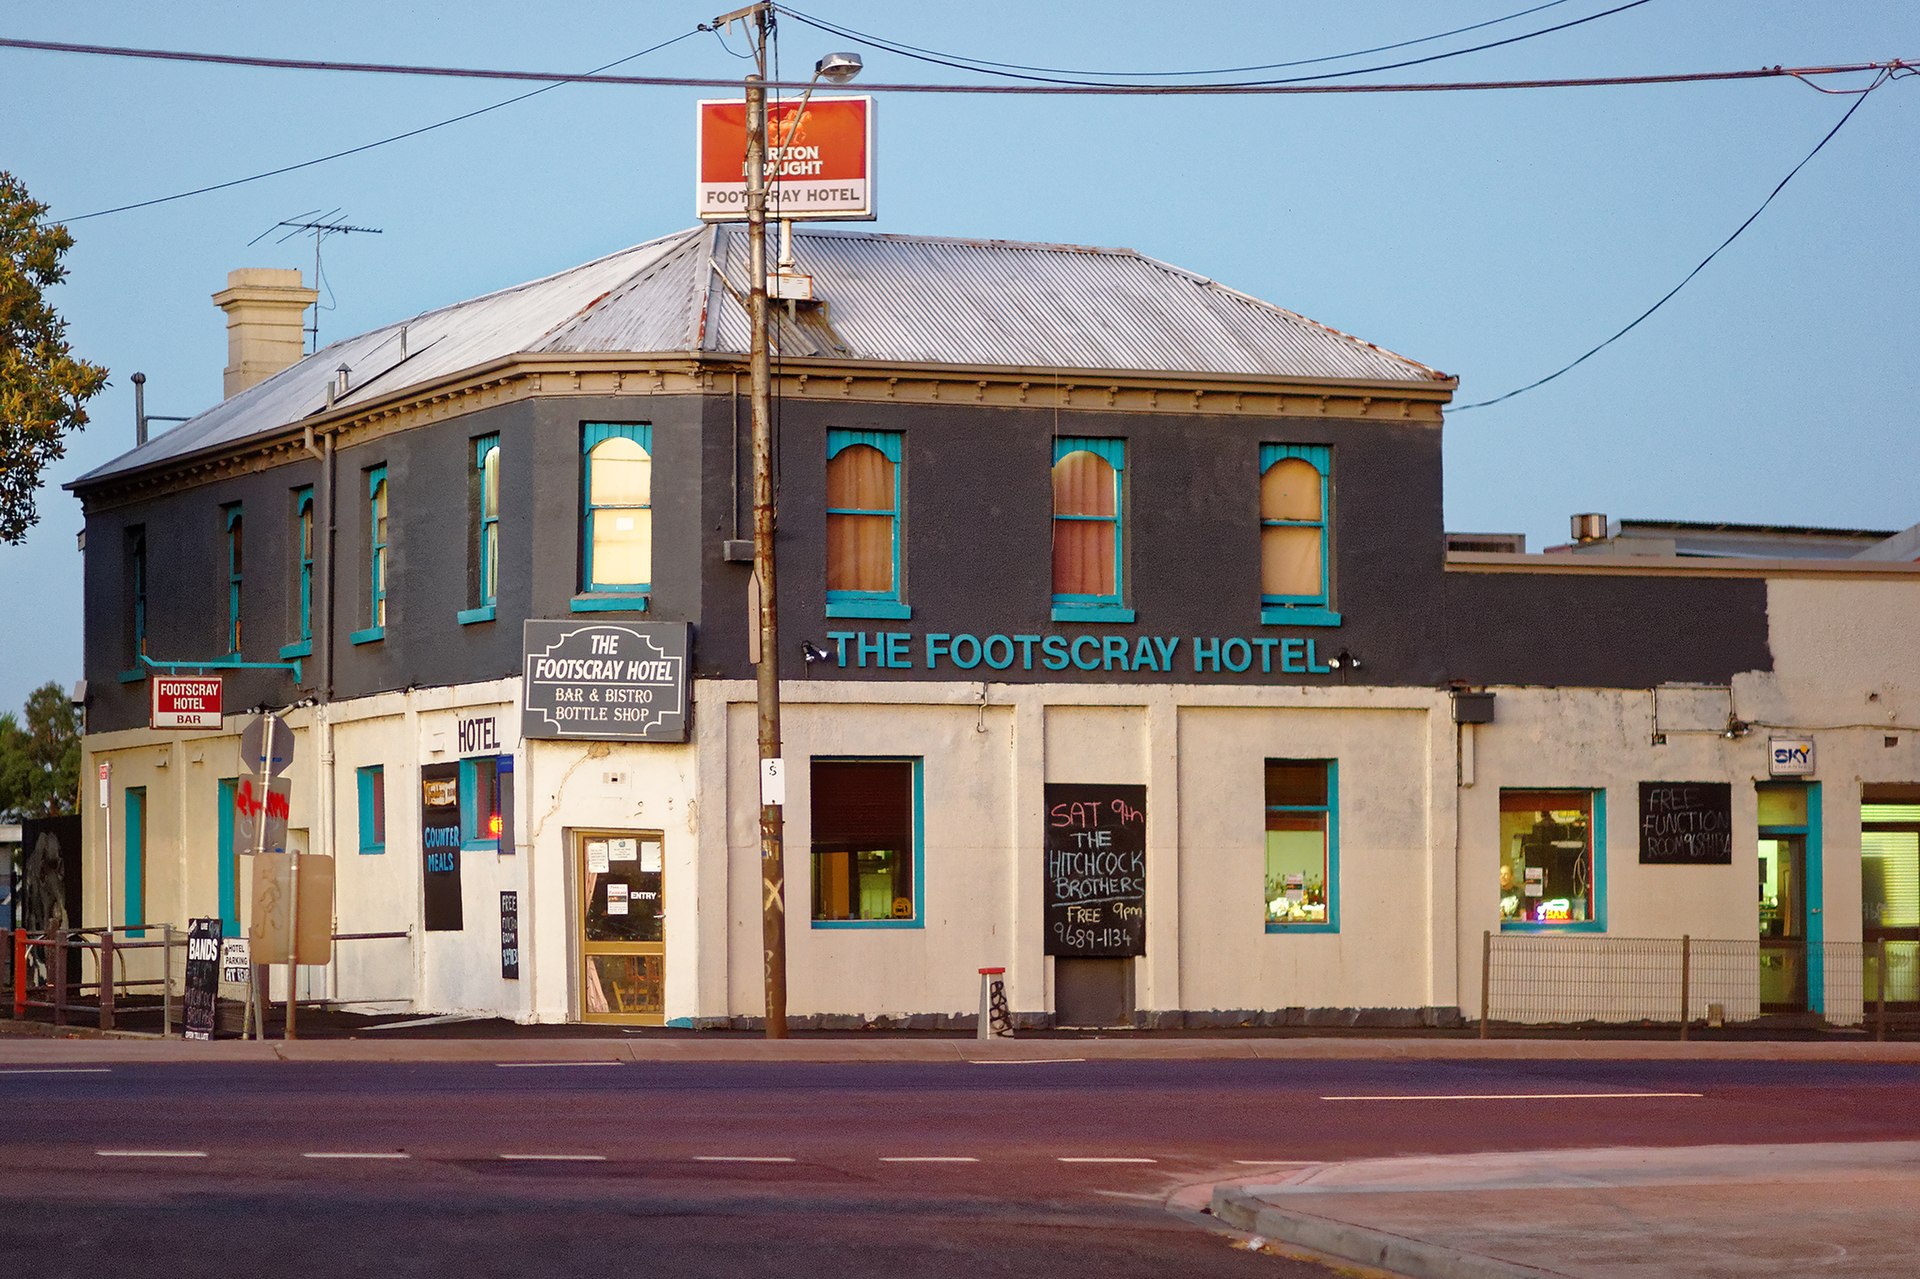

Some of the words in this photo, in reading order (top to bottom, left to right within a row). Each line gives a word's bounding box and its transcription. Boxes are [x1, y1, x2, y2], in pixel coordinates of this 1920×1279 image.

[766, 146, 819, 160] RLTON
[807, 188, 860, 202] HOTEL
[590, 634, 620, 655] THE
[826, 631, 912, 669] THE
[925, 632, 1180, 672] FOOTSCRAY
[1193, 636, 1331, 674] HOTEL
[535, 658, 624, 681] FOOTSCRAY
[626, 660, 673, 681] HOTEL
[160, 683, 219, 696] FOOTSCRAY
[555, 687, 584, 703] BAR
[589, 688, 600, 702] &
[605, 689, 653, 704] BISTRO
[173, 697, 206, 710] HOTEL
[176, 715, 201, 724] BAR
[555, 706, 608, 721] BOTTLE
[613, 707, 650, 722] SHOP
[458, 717, 500, 752] HOTEL
[1774, 746, 1811, 765] SKY
[1649, 787, 1704, 812] FREE
[1051, 801, 1102, 828] SAT
[1643, 811, 1730, 836] FUNCTION
[424, 825, 460, 848] COUNTER
[1070, 830, 1112, 848] THE
[1647, 835, 1684, 858] ROOM
[428, 852, 455, 872] MEALS
[1050, 850, 1146, 878] HITCHCOCK
[630, 891, 657, 900] ENTRY
[1052, 876, 1145, 900] BROTHERS
[501, 895, 517, 912] FREE
[1067, 906, 1102, 924] FREE
[1112, 902, 1143, 921] 9pm
[1546, 909, 1569, 919] BAR
[1053, 921, 1132, 949] 9689-1134
[188, 938, 218, 962] BANDS
[228, 944, 245, 953] HOTEL
[225, 956, 248, 965] PARKING
[226, 968, 236, 982] AT
